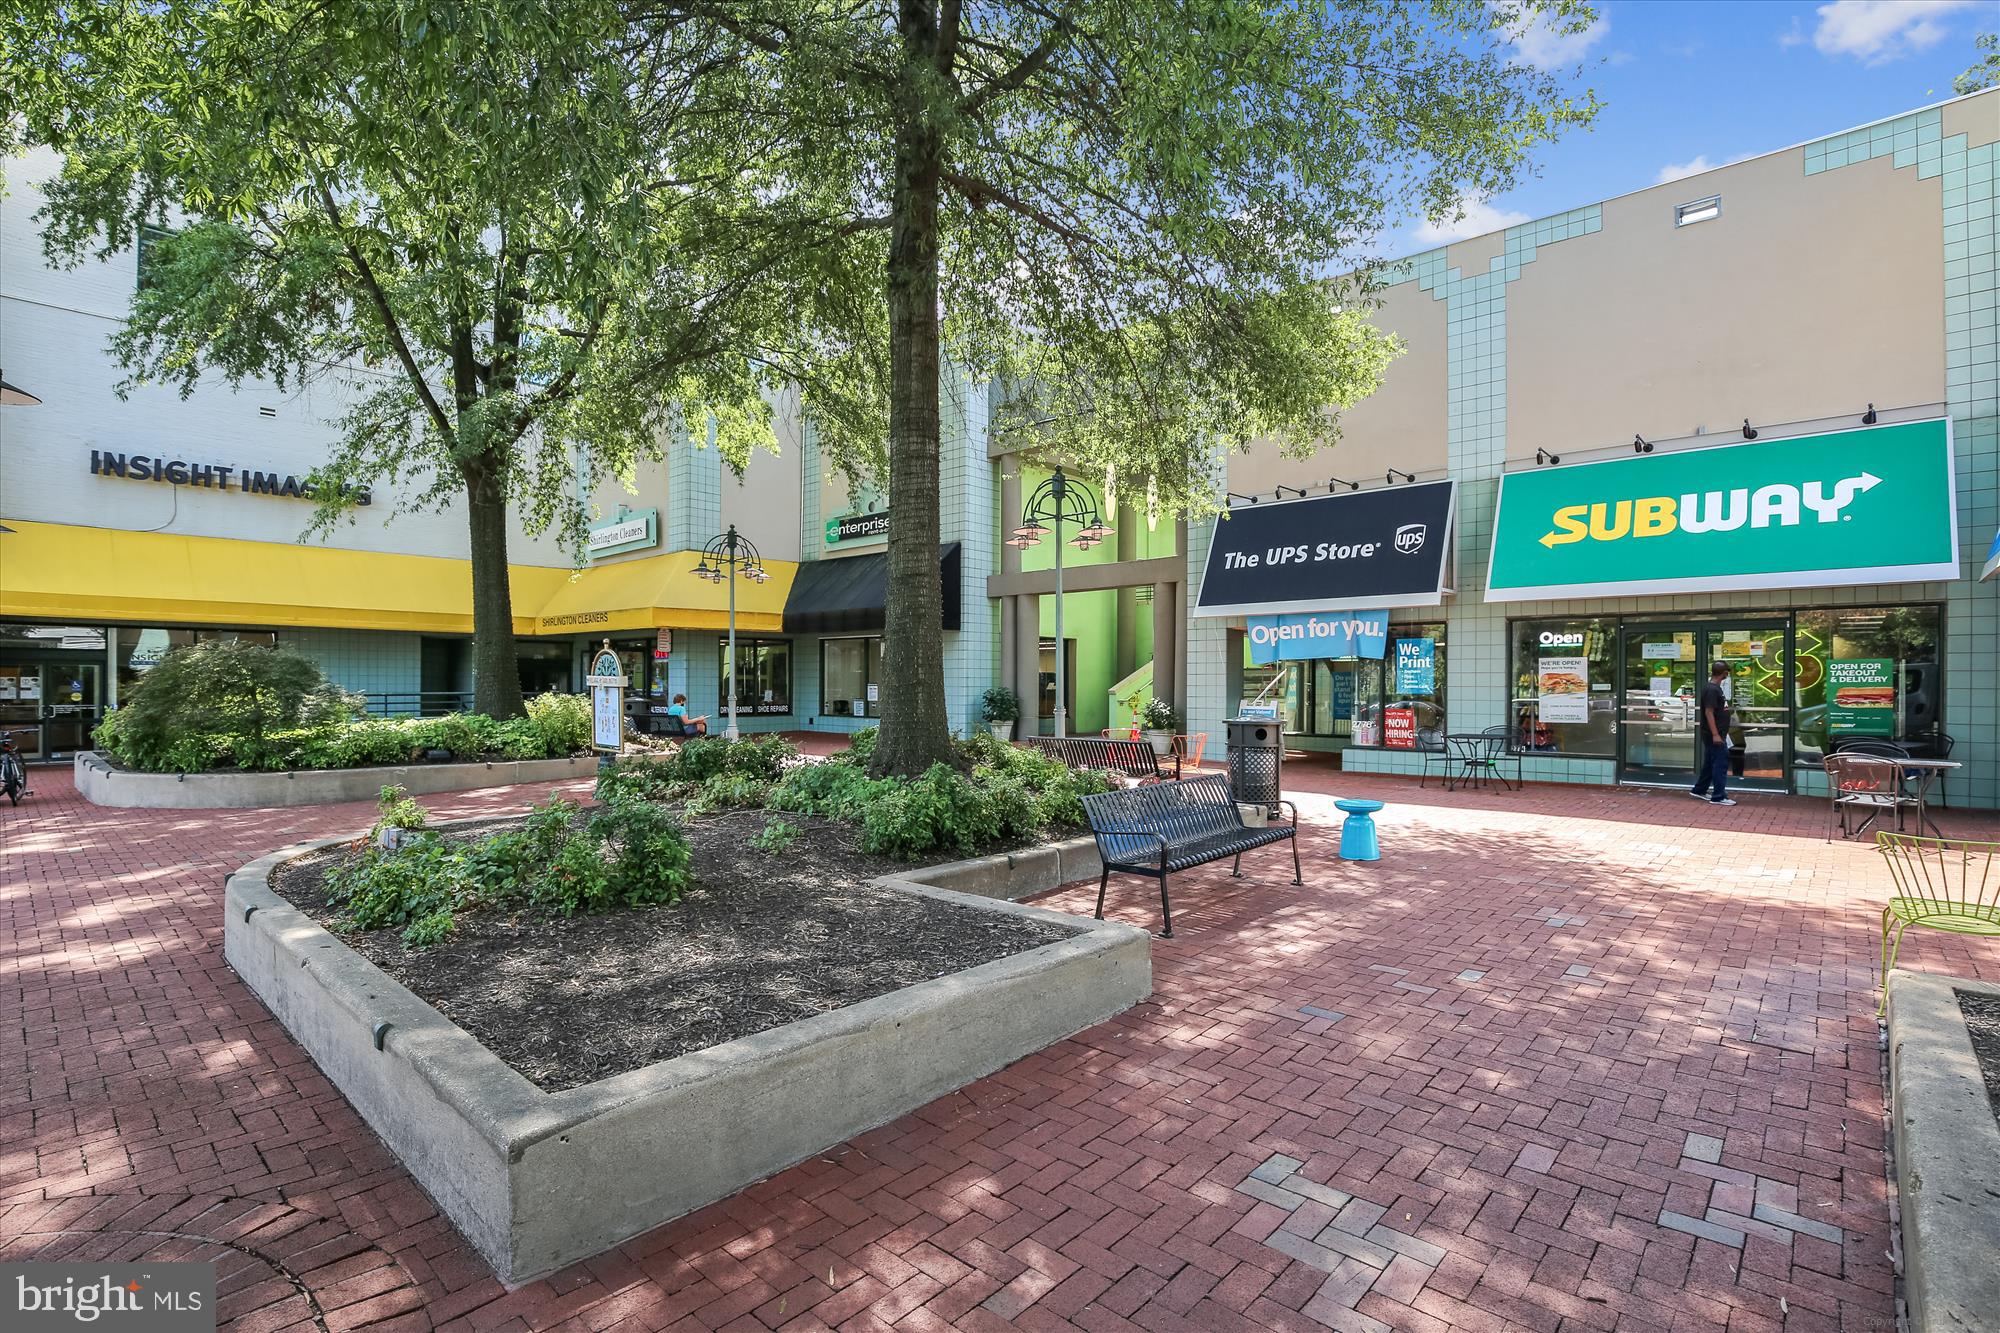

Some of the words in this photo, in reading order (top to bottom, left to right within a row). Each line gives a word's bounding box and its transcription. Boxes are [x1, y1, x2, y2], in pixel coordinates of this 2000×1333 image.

[91, 450, 233, 490] INSIGHT
[1538, 472, 1884, 549] SUBWAY
[620, 527, 643, 539] Cleaners
[830, 517, 890, 536] enterprise
[1225, 551, 1259, 569] The
[1266, 545, 1308, 565] UPS
[1314, 543, 1375, 561] Store
[542, 616, 577, 627] SHIRLINGTON
[577, 612, 608, 624] CLEANERS
[1251, 625, 1304, 647] Open
[1307, 618, 1338, 638] for
[1341, 619, 1384, 640] you.
[1539, 631, 1584, 647] Open
[1399, 643, 1420, 656] We
[1400, 656, 1431, 668] Print
[757, 705, 770, 713] SHOE
[1388, 719, 1410, 728] NOW
[1385, 729, 1414, 739] HIRING
